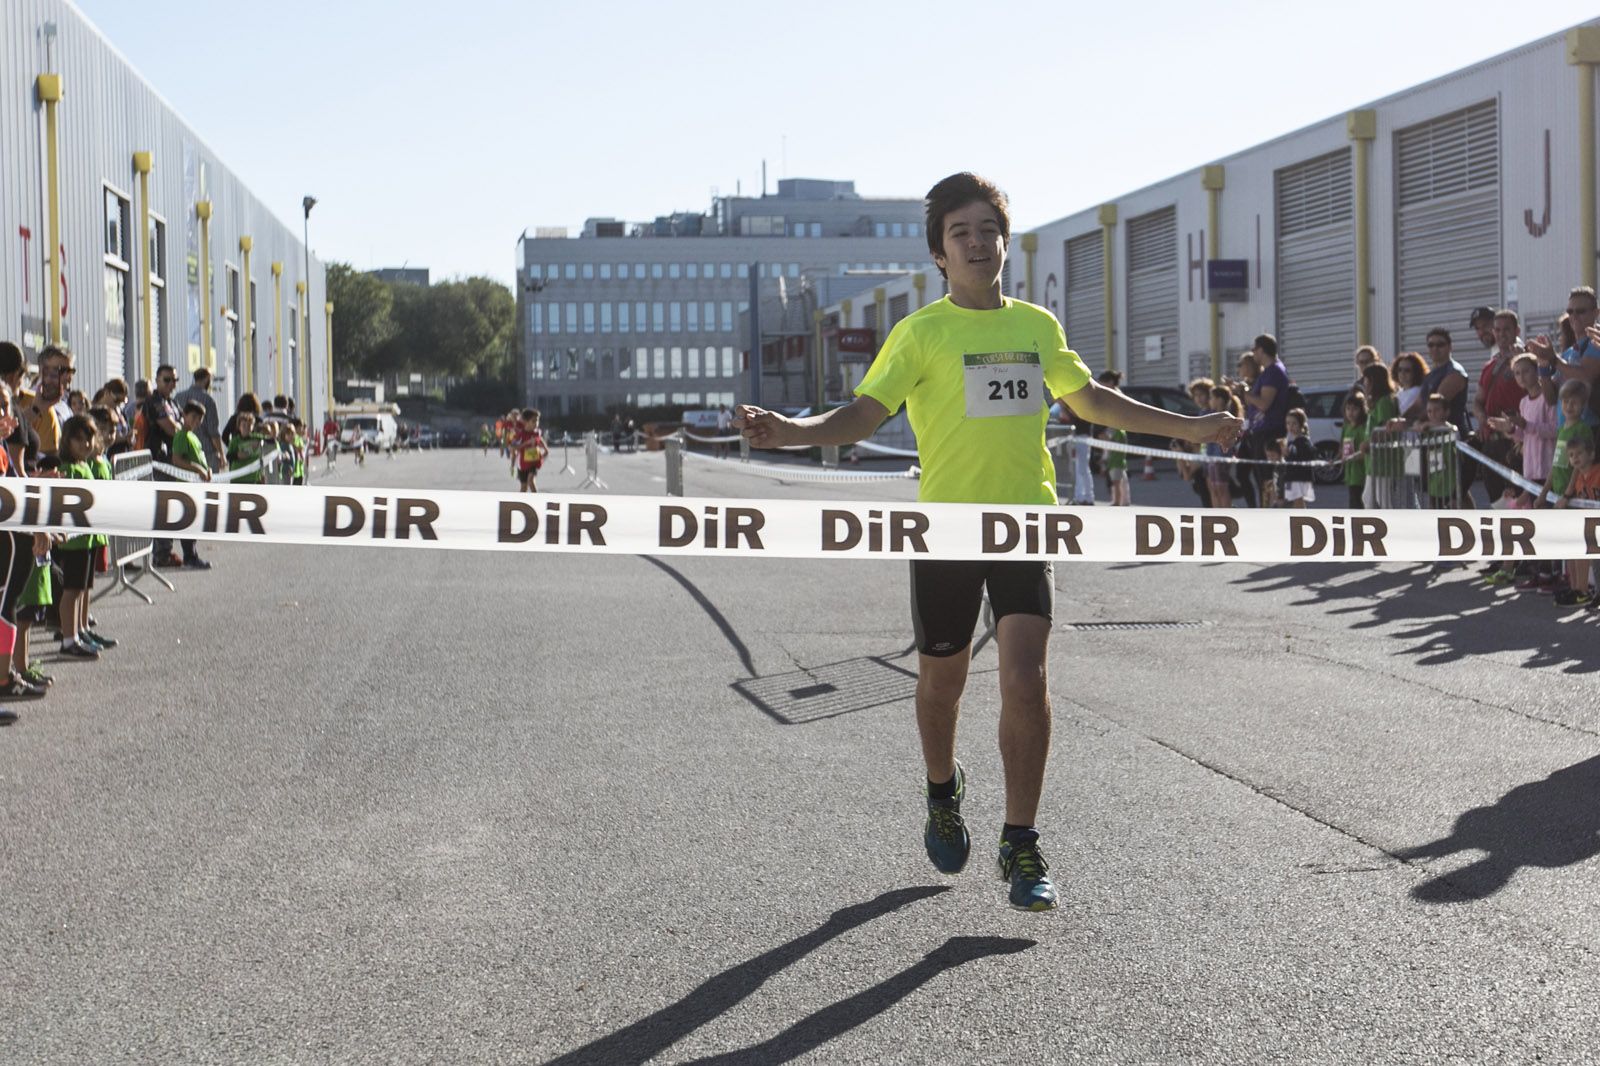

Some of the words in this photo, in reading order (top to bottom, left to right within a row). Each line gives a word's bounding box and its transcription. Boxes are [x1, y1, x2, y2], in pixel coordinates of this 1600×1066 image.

[1523, 129, 1552, 238] J
[19, 224, 31, 304] T
[1187, 229, 1206, 302] H
[988, 380, 1029, 401] 218
[152, 490, 267, 534] DiR
[323, 496, 439, 540] DiR
[498, 501, 607, 545] DiR
[659, 506, 765, 549] DiR
[822, 510, 930, 552] DiR
[982, 512, 1083, 555] DiR
[1136, 515, 1239, 556] DiR
[1290, 516, 1387, 556] DiR
[1438, 518, 1536, 556] DiR
